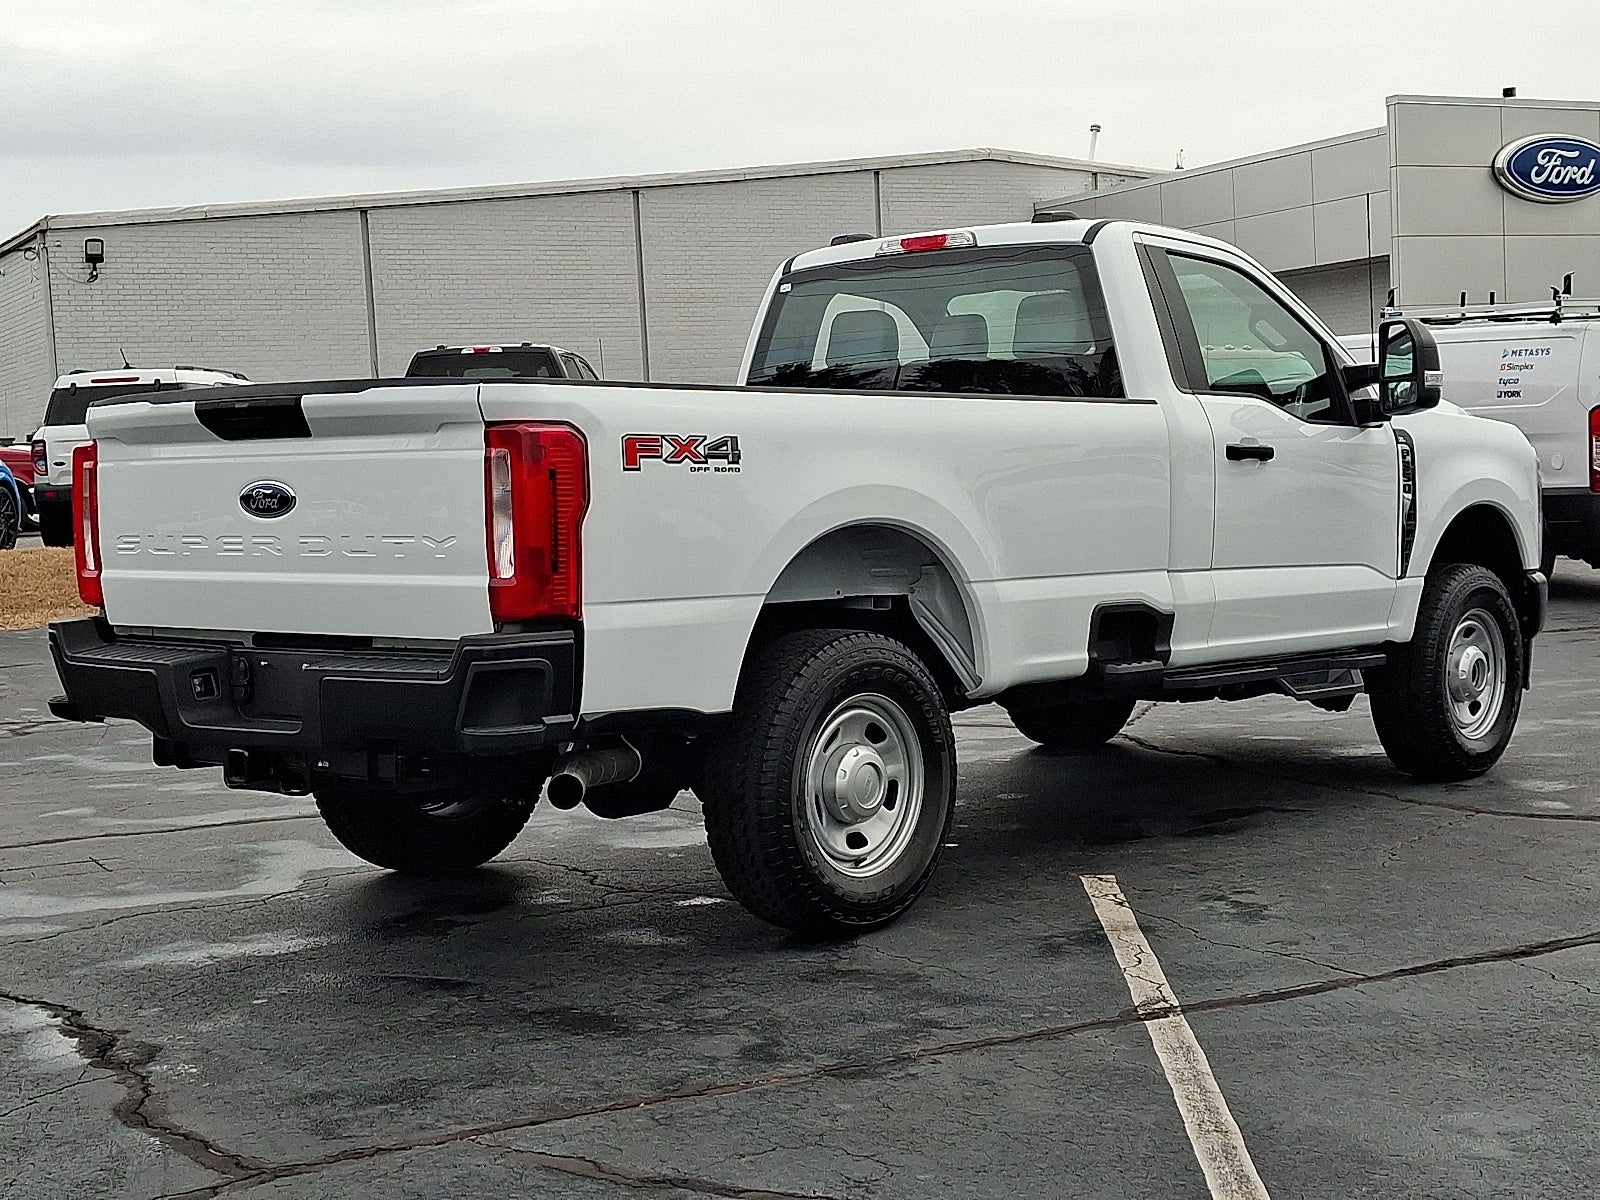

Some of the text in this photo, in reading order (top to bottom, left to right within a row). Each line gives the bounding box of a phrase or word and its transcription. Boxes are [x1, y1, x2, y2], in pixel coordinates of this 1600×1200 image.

[1530, 148, 1596, 185] Ford
[1510, 347, 1551, 357] METASYS
[1498, 377, 1520, 387] tyco
[1502, 390, 1522, 399] YORK
[621, 433, 741, 471] FX4
[250, 488, 281, 509] Ford
[116, 535, 457, 558] SUPER DUTY
